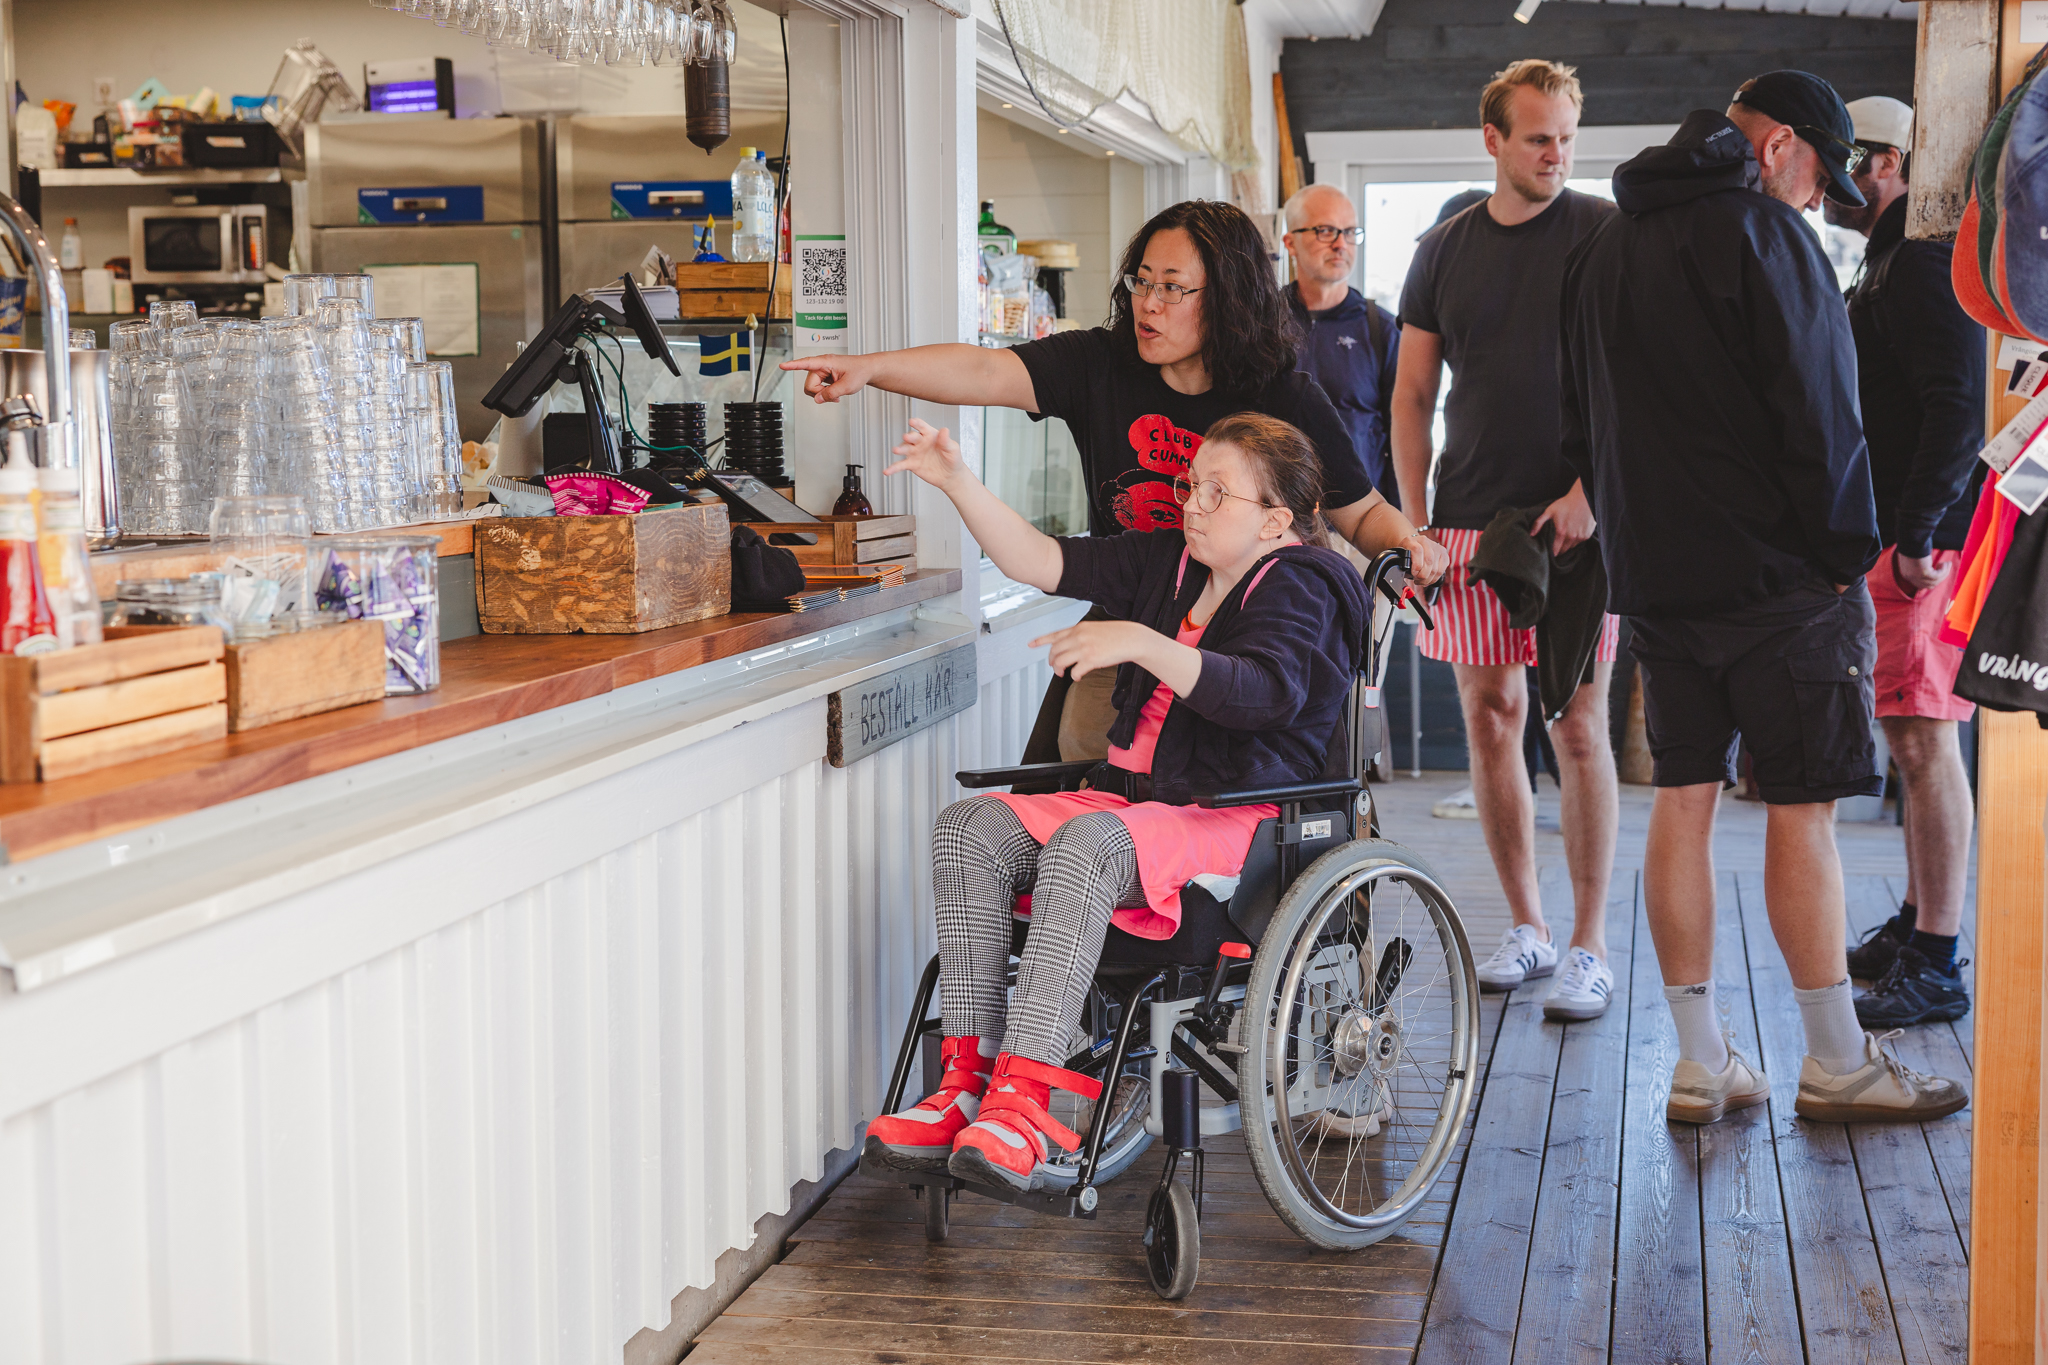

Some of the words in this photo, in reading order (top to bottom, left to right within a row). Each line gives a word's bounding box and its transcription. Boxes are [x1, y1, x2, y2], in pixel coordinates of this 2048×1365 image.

[1149, 428, 1193, 449] CLUB
[1149, 448, 1191, 469] CUMM
[1978, 651, 2048, 691] VRÅNG
[861, 674, 919, 746] BESTÄLL
